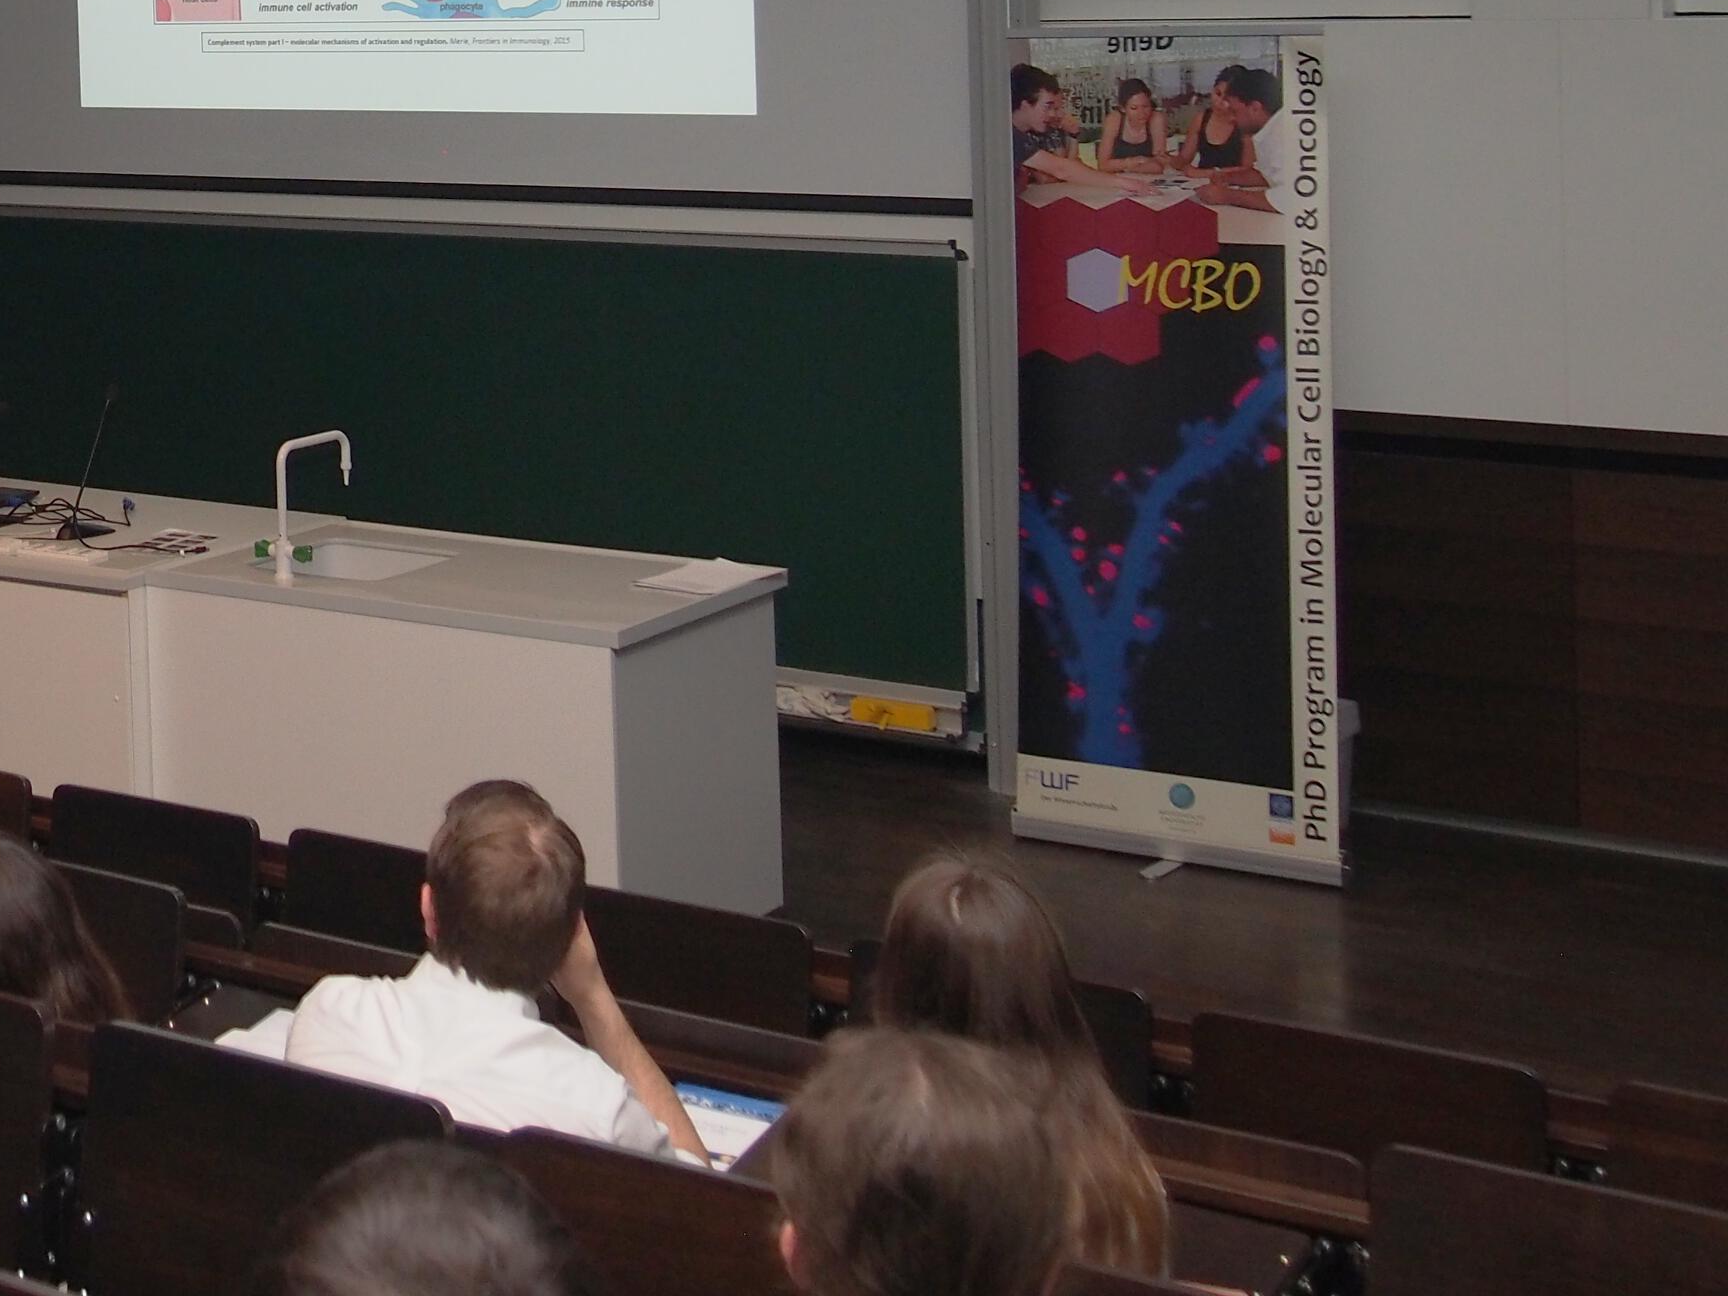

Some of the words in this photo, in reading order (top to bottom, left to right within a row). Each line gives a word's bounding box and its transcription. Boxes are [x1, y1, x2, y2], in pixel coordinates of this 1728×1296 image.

[258, 3, 294, 12] immune
[296, 2, 312, 12] cell
[314, 2, 358, 11] activation
[440, 2, 483, 12] phagocyte
[207, 38, 245, 47] Complement
[1292, 51, 1323, 198] Oncology
[1295, 208, 1318, 231] &
[1117, 254, 1262, 313] MCBO
[1294, 240, 1327, 357] Biology
[1296, 367, 1322, 424] Cell
[1297, 432, 1324, 588] Molecular
[1300, 599, 1324, 625] in
[1304, 640, 1334, 771] Program
[1025, 769, 1080, 791] FWF
[1304, 780, 1327, 842] PhD
